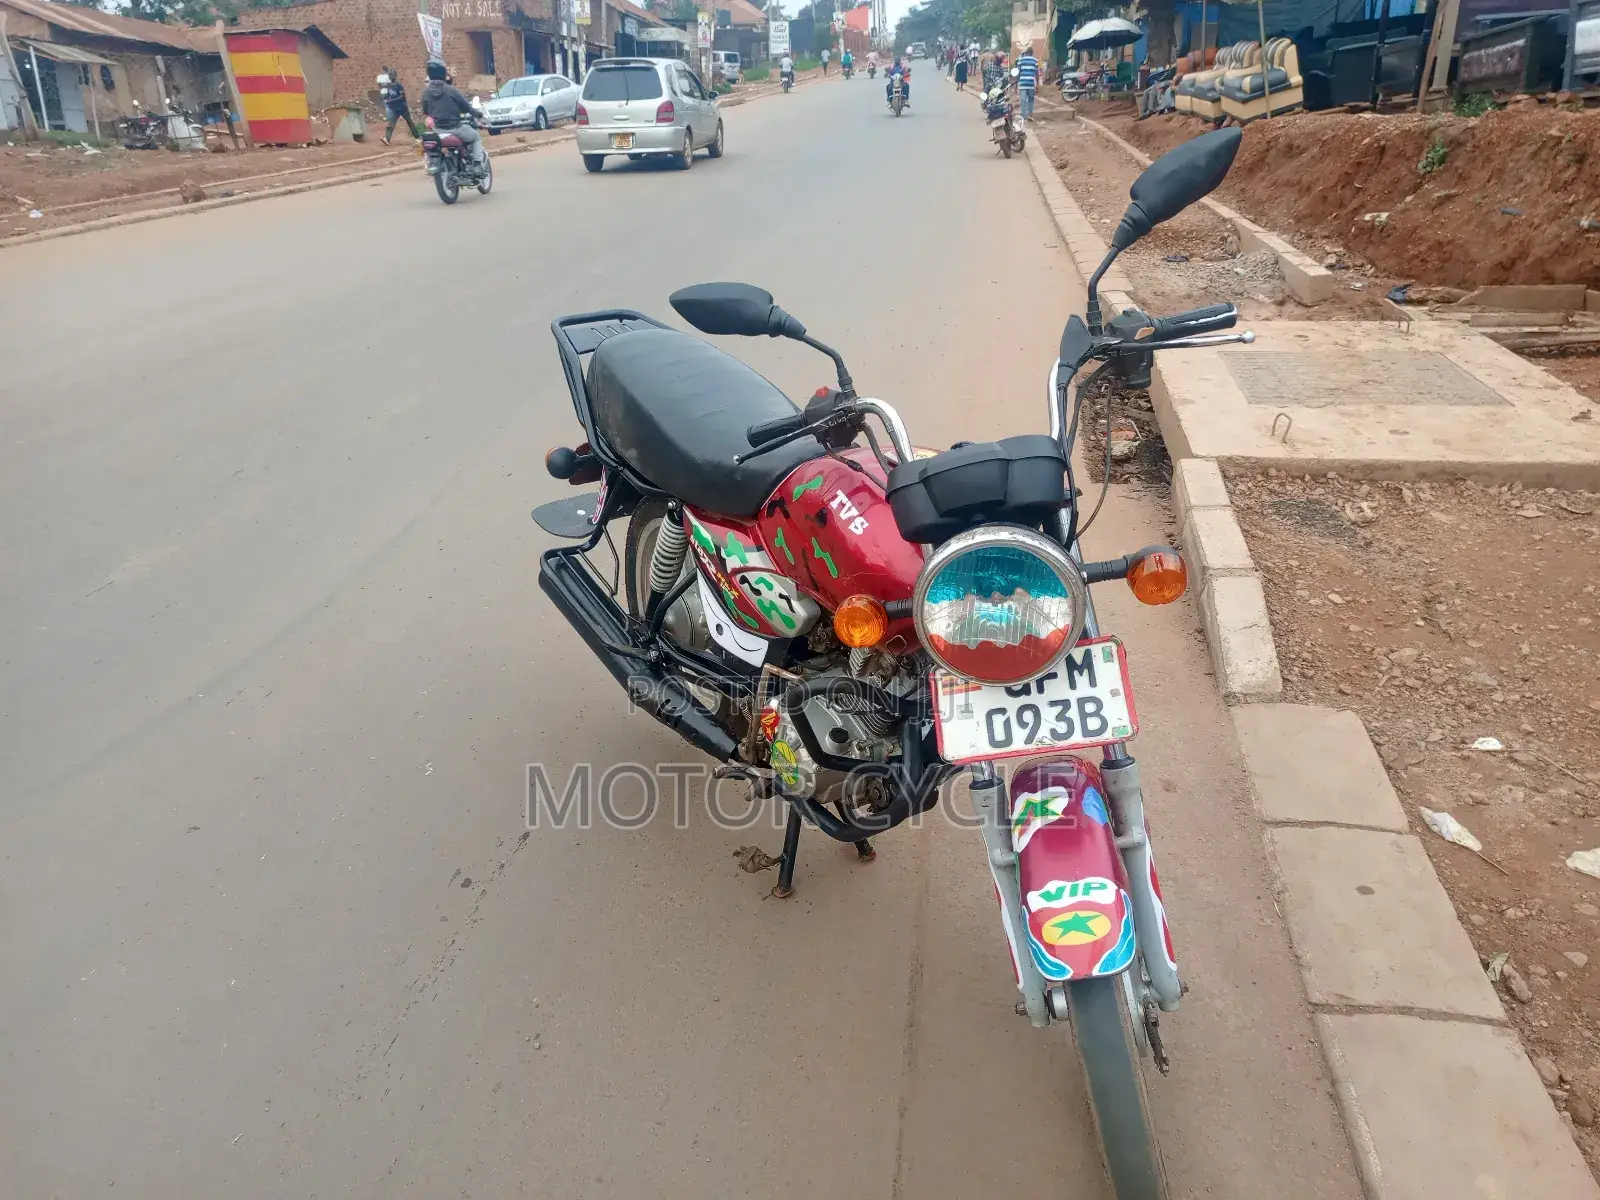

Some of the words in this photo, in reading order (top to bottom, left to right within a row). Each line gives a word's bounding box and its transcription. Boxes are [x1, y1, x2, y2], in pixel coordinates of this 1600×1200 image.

[442, 3, 460, 19] NOT
[464, 2, 472, 17] 4
[477, 1, 503, 17] SALE
[828, 489, 870, 536] TVS
[985, 696, 1109, 749] 093B
[1038, 881, 1109, 903] VIP
